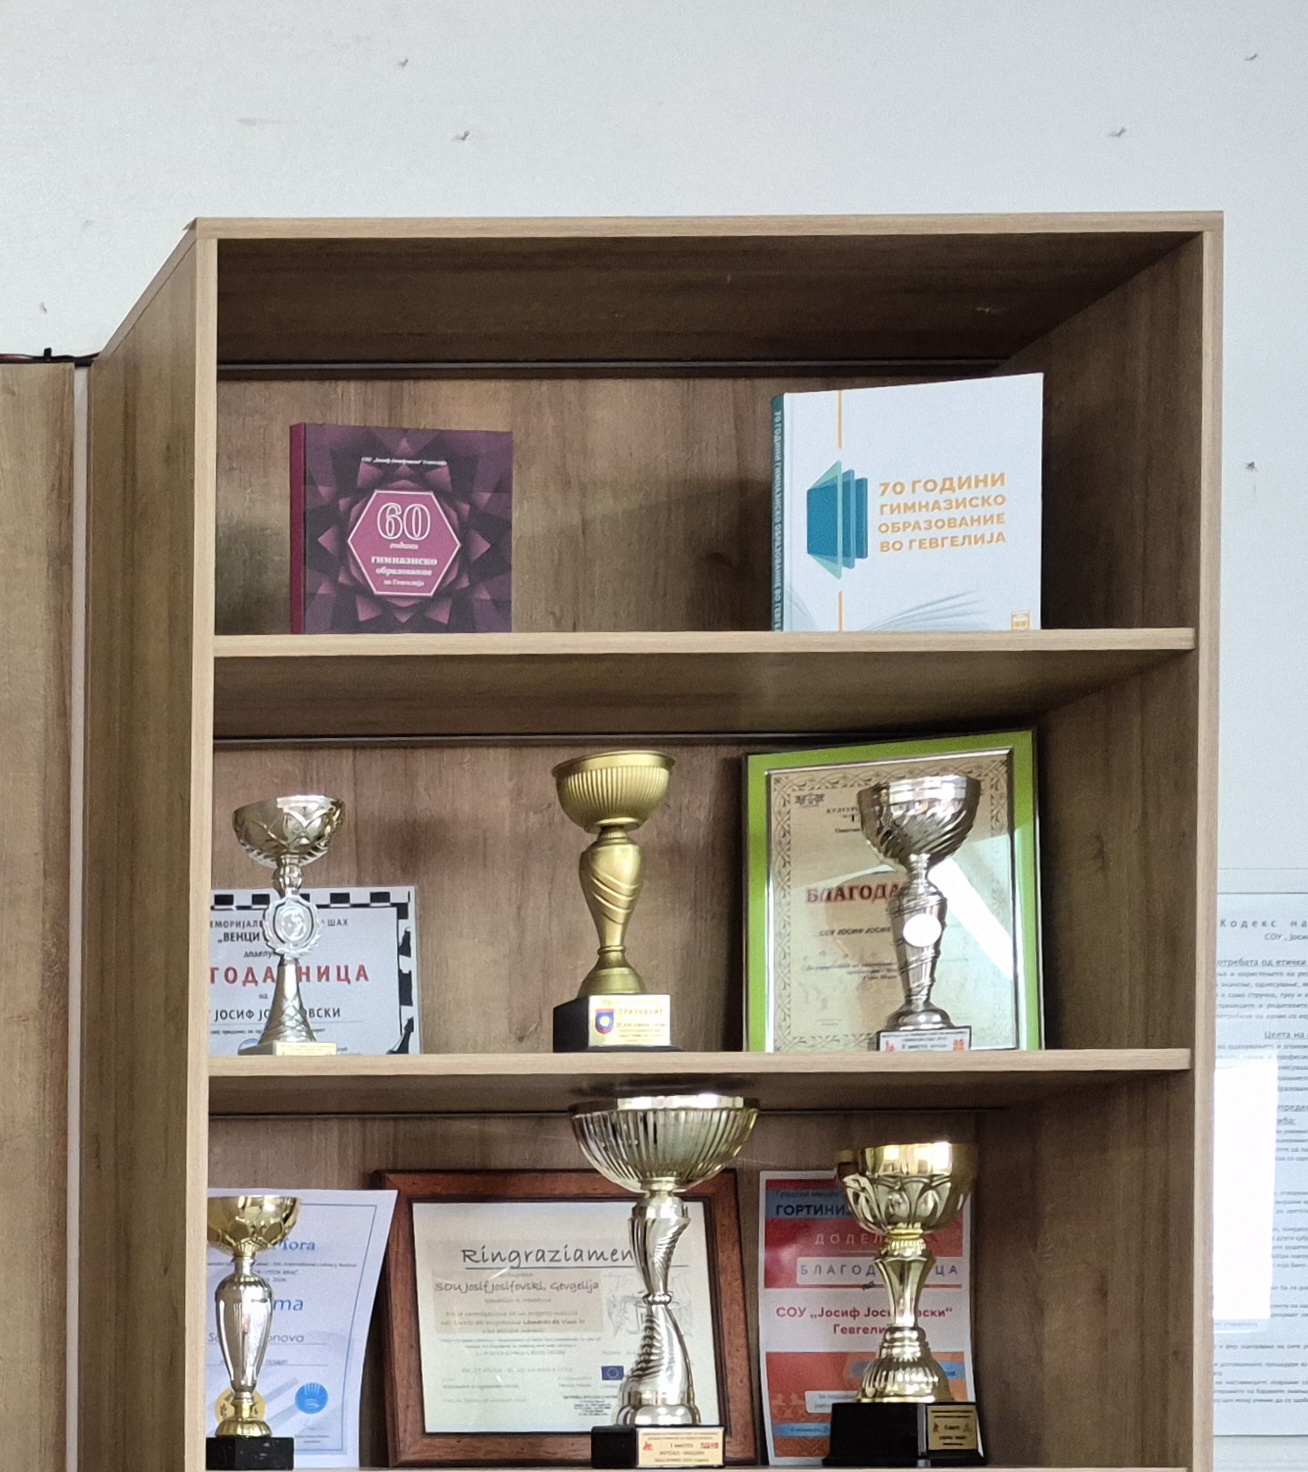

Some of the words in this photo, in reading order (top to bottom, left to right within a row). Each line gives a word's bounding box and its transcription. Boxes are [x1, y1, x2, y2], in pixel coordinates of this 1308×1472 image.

[879, 482, 906, 497] 70
[911, 472, 1007, 495] ГОДИНИ
[879, 494, 1007, 516] ГИМНАЗИСКО
[377, 502, 431, 541] 60
[878, 513, 1006, 534] ОБРАЗОВАНИЕ
[879, 541, 903, 553] ВО
[909, 532, 1006, 551] ГЕВГЕЛИЈА
[806, 883, 901, 904] БЛАГОДА
[327, 919, 348, 927] ШАХ
[1220, 919, 1277, 928] Кодекс
[210, 963, 369, 987] ГОДАНИЦА
[214, 1009, 255, 1022] ЈОСИФ
[775, 1204, 851, 1217] ГОРТИНИ
[461, 1245, 634, 1268] Ringraziamen
[801, 1263, 958, 1277] БЛАГОДЦА
[776, 1306, 806, 1318] СОУ
